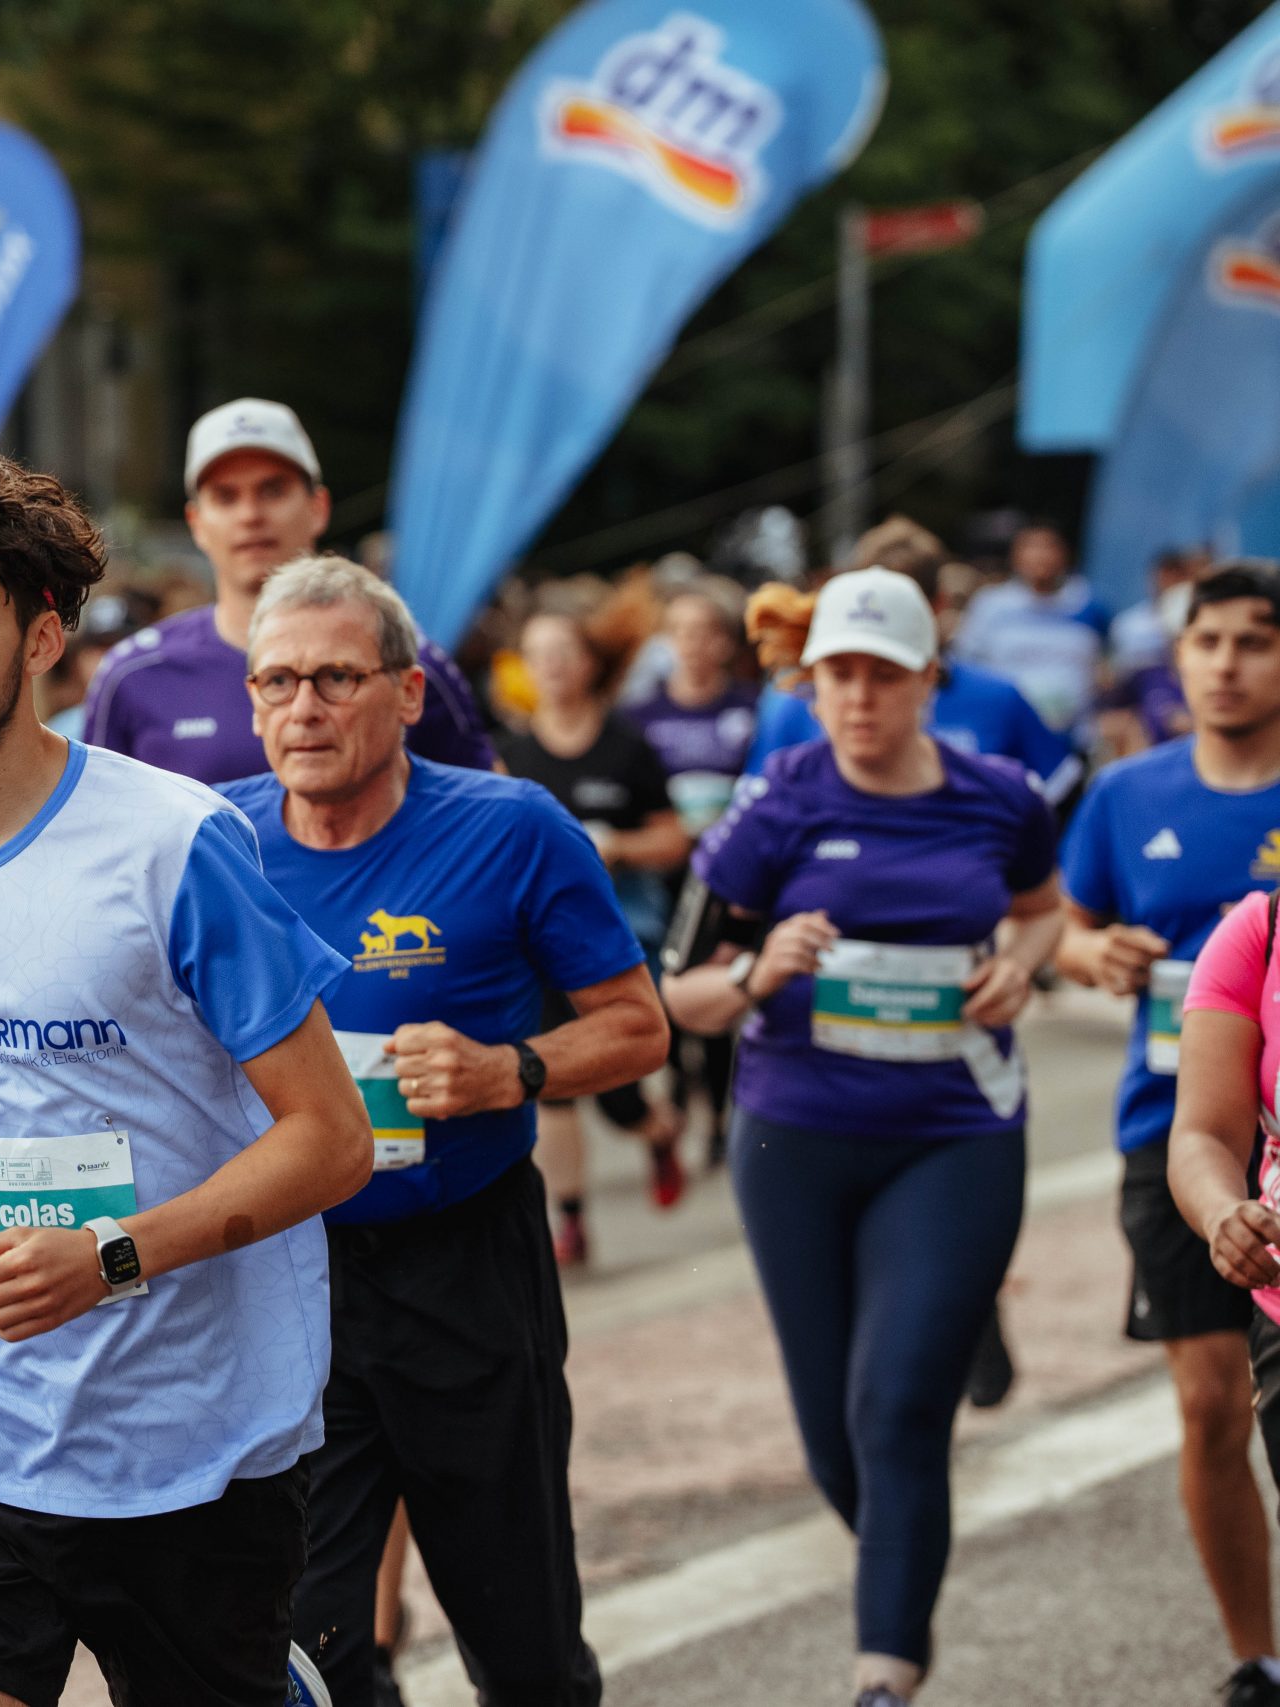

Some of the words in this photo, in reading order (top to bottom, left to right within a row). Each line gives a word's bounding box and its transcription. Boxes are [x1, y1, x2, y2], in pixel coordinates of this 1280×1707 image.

[608, 33, 760, 150] dm
[40, 1052, 52, 1067] &
[54, 1043, 129, 1065] Elektronik
